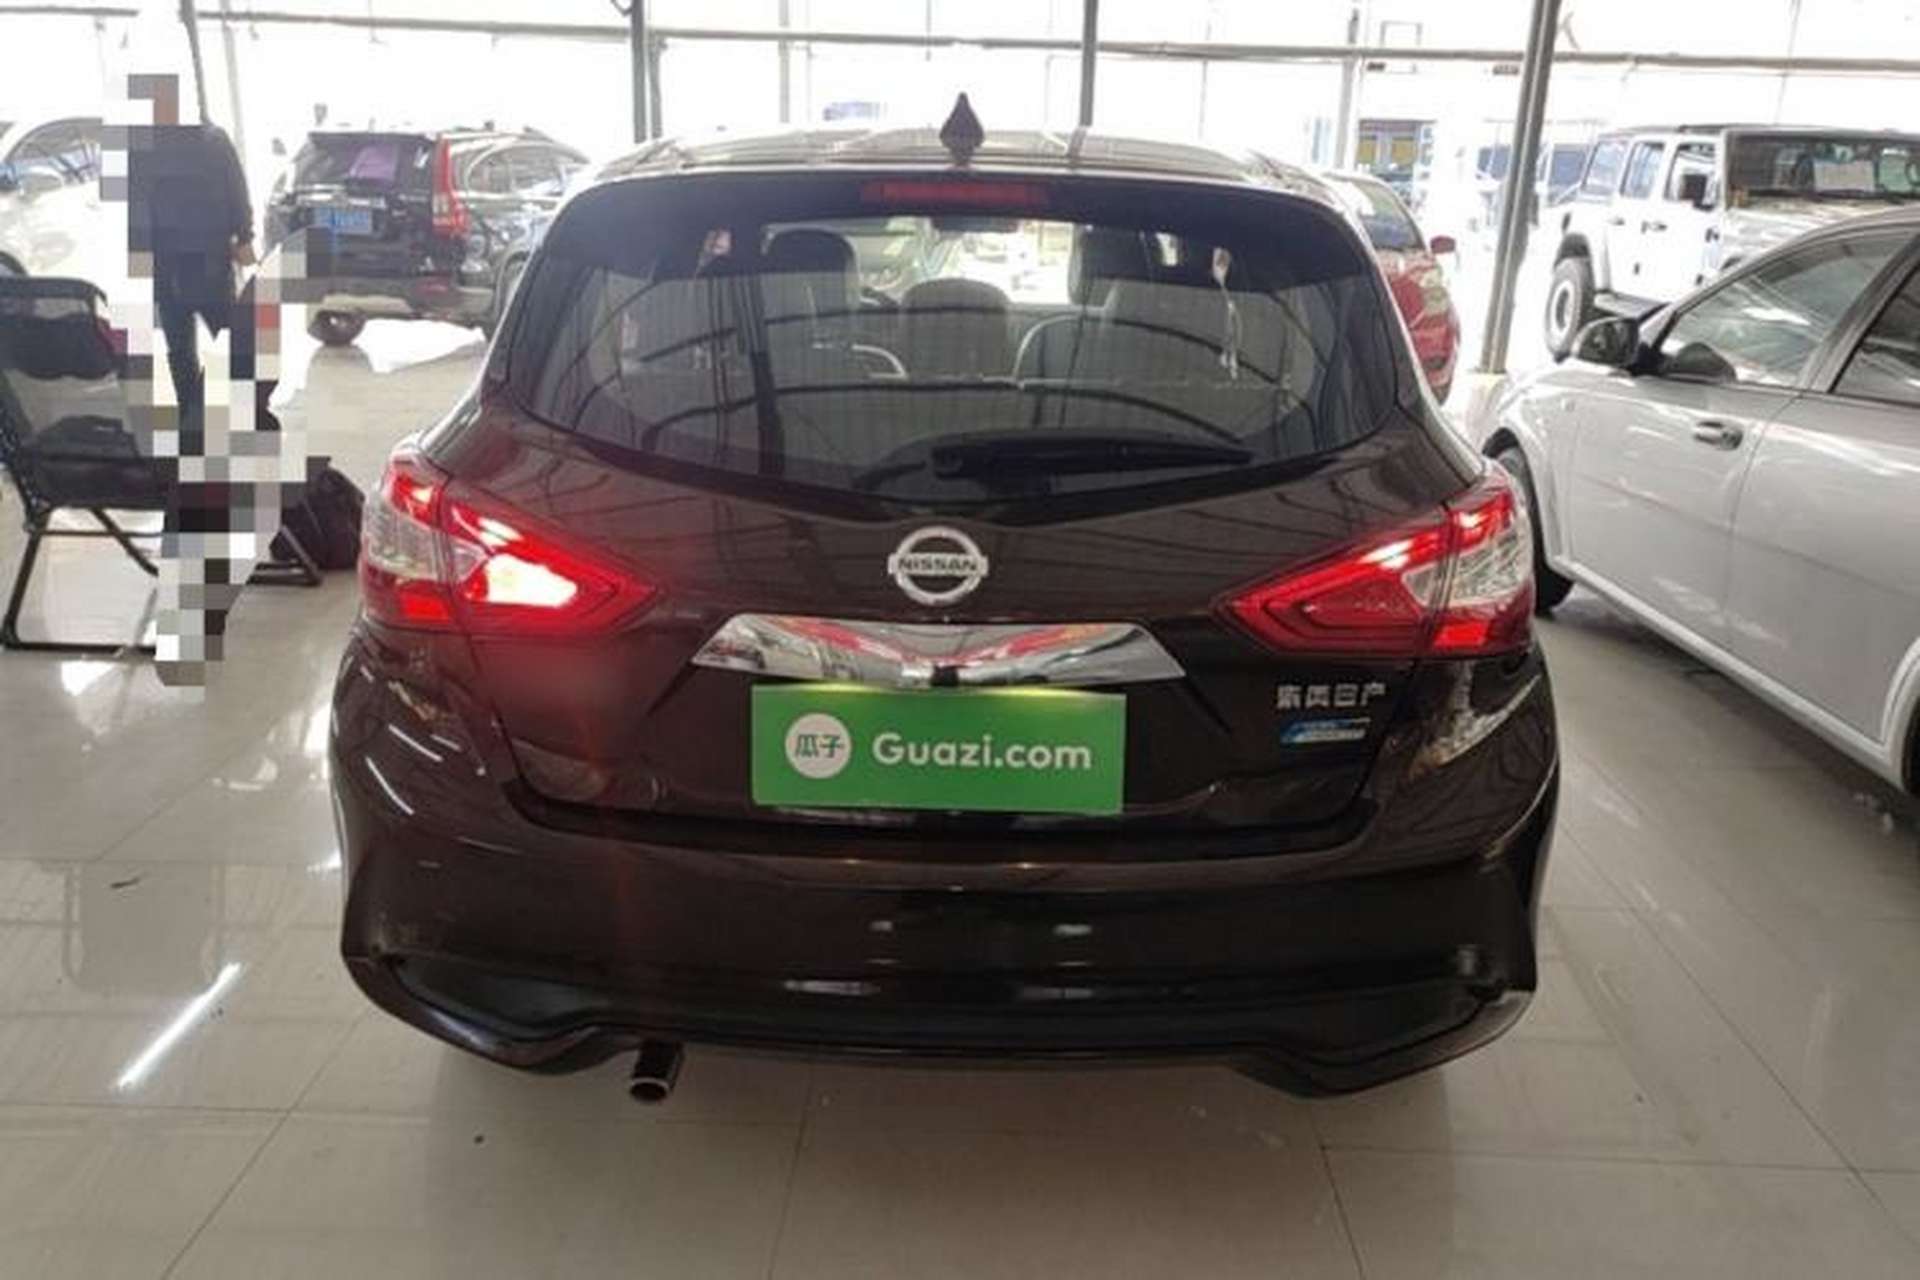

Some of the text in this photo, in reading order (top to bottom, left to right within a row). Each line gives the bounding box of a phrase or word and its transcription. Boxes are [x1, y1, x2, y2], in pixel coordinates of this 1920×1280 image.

[898, 555, 979, 573] NISSAN
[794, 733, 845, 760] 瓜子
[872, 731, 1092, 769] Guazi.com
